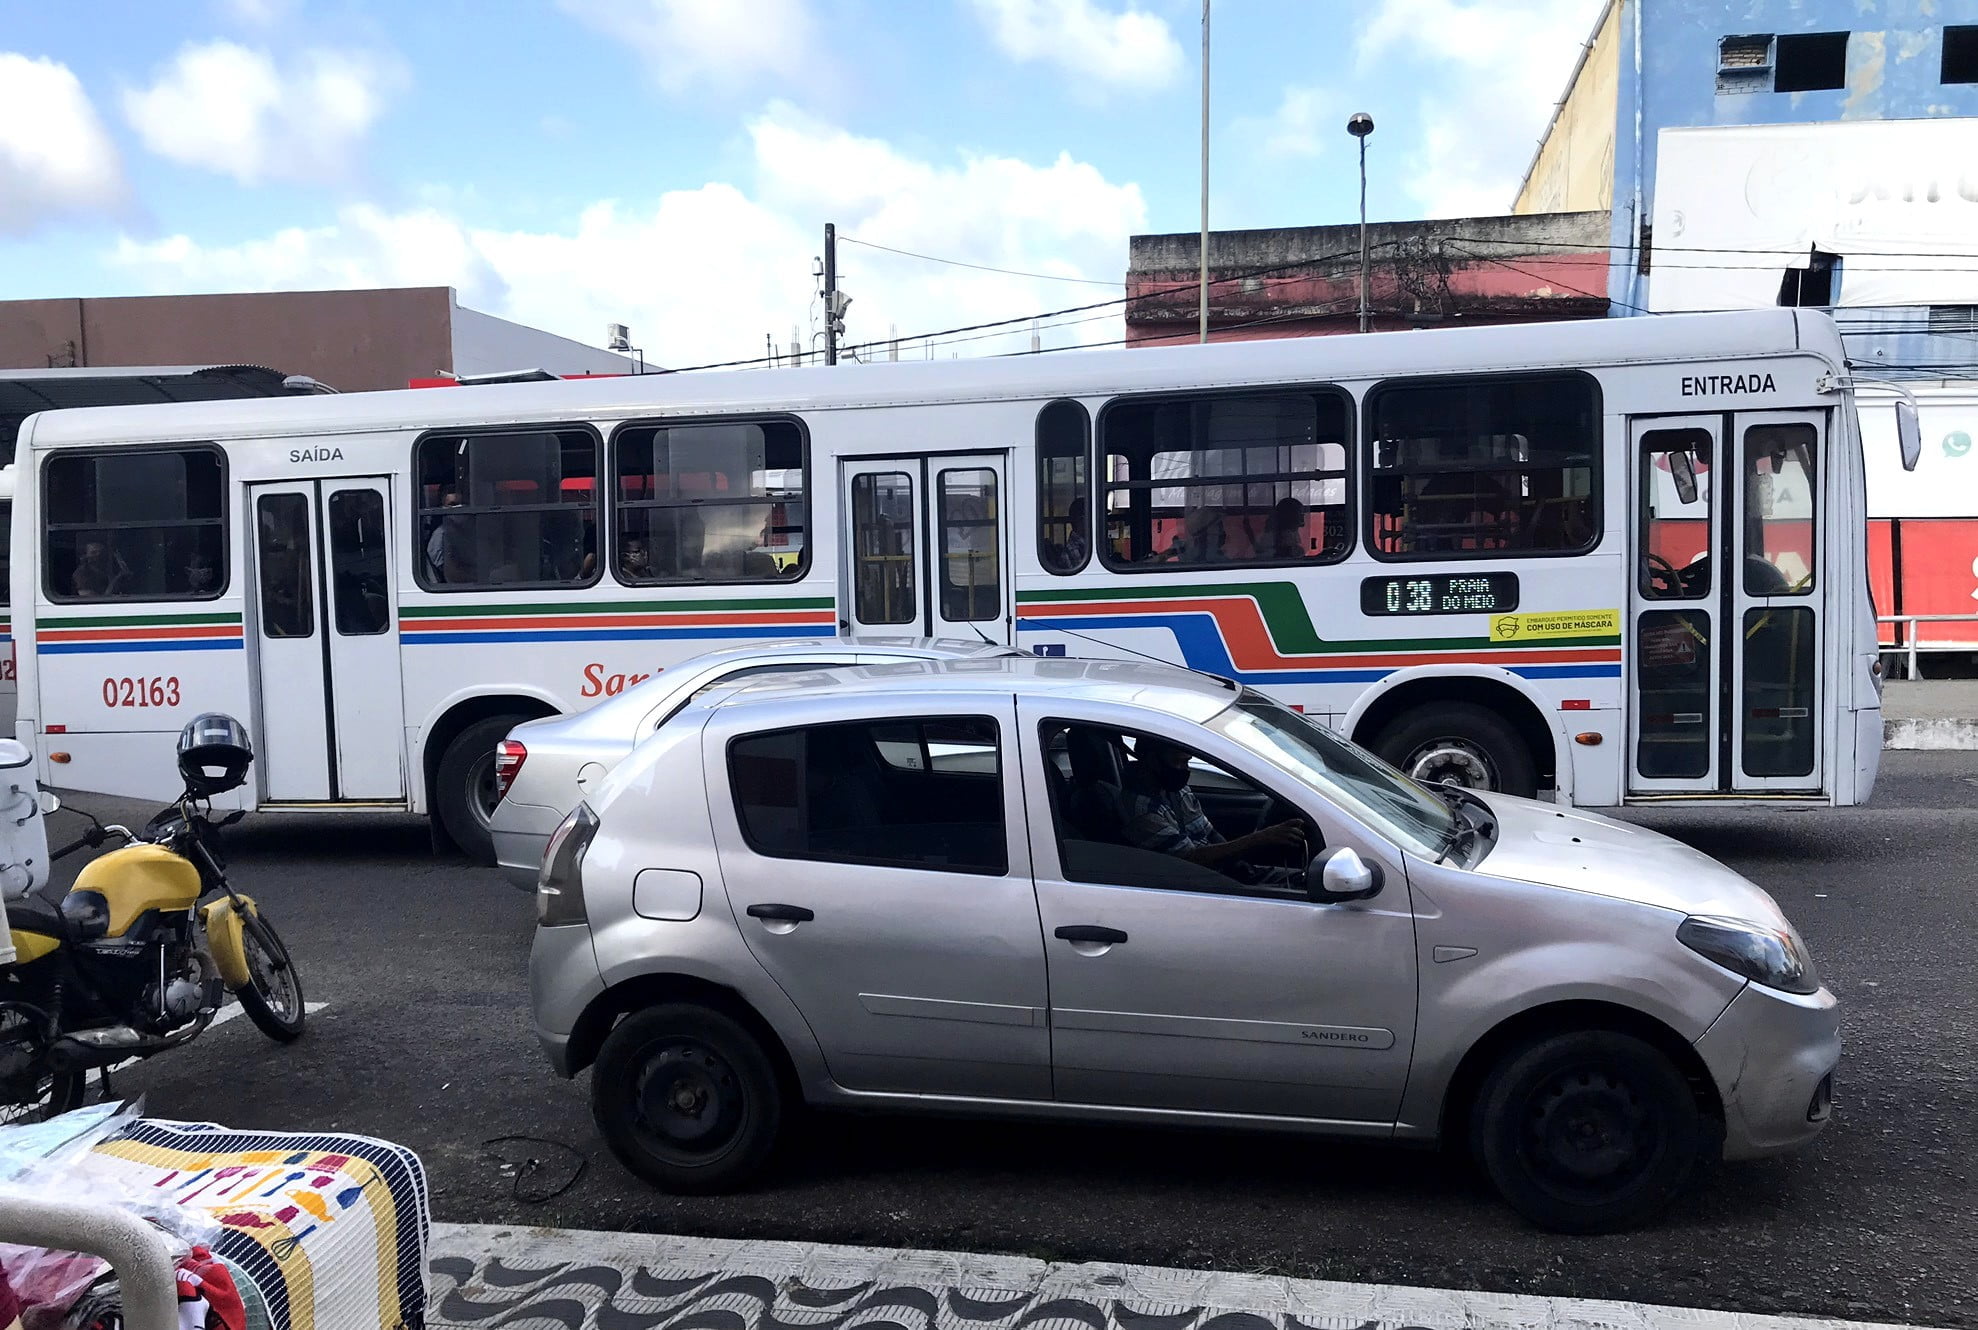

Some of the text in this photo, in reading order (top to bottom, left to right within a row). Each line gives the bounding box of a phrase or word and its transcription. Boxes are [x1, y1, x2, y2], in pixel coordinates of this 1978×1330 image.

[1681, 373, 1776, 396] ENTRADA
[289, 445, 344, 463] SAÍDA
[1449, 578, 1490, 594] PRAIA
[1442, 594, 1496, 610] DO MEIO
[1526, 616, 1556, 624] EMBARQUE
[1586, 613, 1613, 621] SOMENTE
[1526, 623, 1544, 632] COM
[1544, 622, 1561, 631] USO
[1562, 621, 1572, 630] DE
[1574, 620, 1613, 630] MÁSCARA
[102, 676, 181, 708] 02163
[1301, 1030, 1369, 1042] SANDERO
